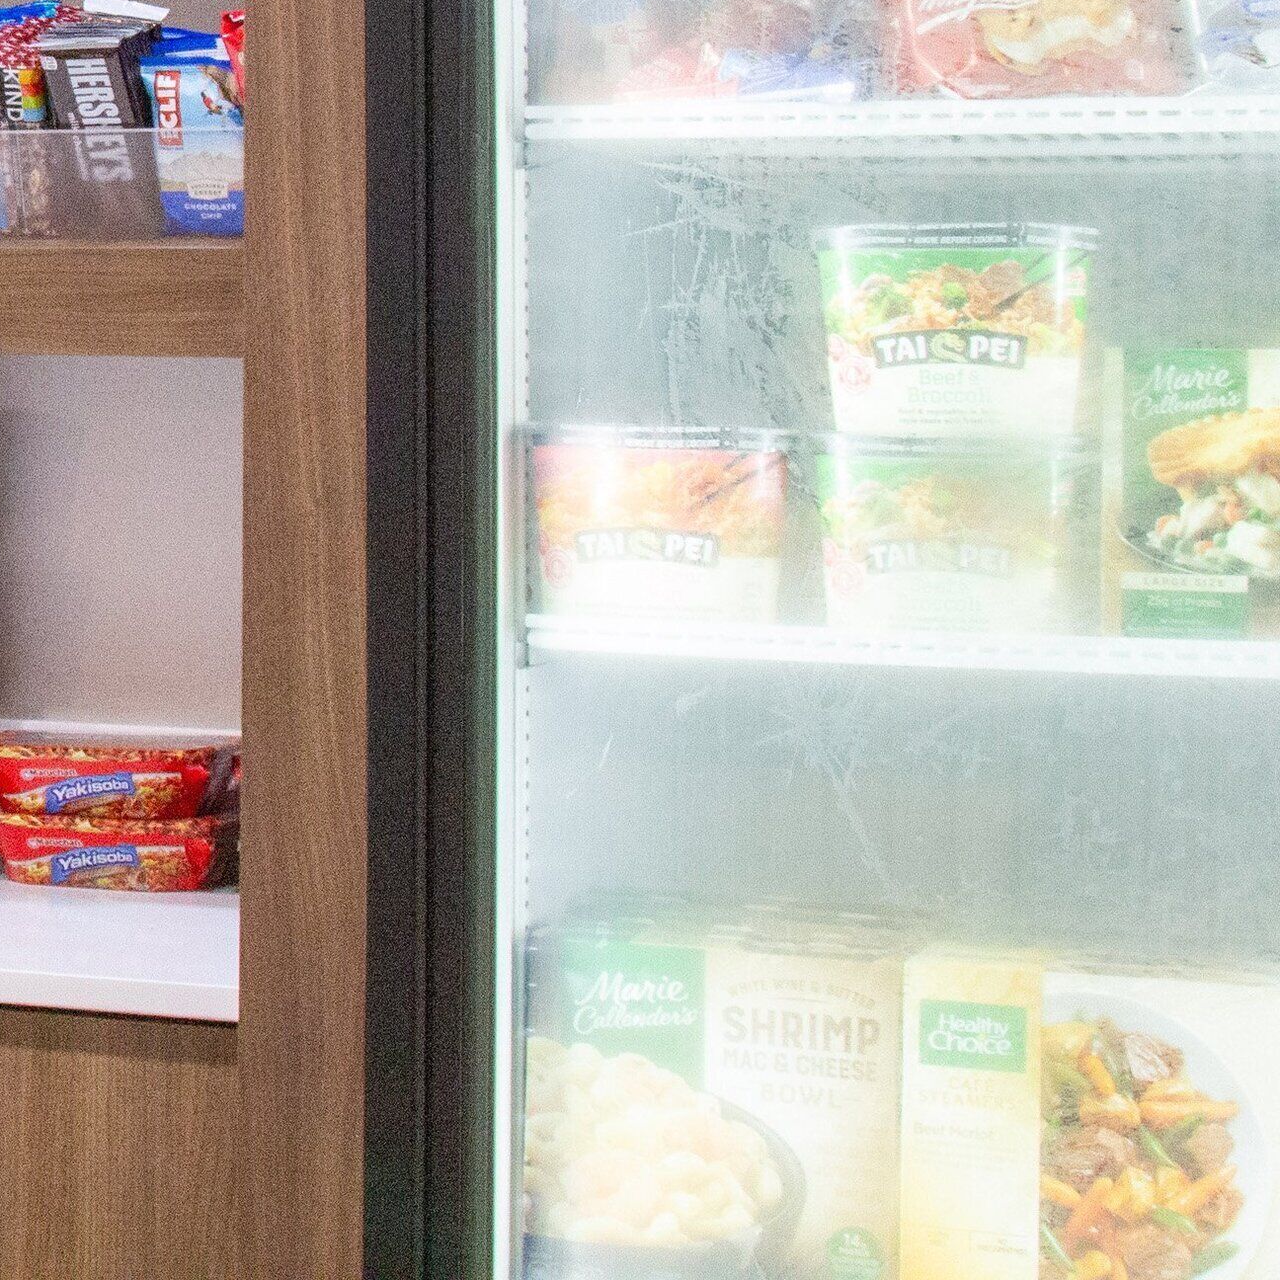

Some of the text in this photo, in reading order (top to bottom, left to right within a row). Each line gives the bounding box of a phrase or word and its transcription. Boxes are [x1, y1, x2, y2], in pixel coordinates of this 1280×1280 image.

[4, 69, 25, 121] KIND
[160, 73, 180, 131] CLIF
[876, 334, 1023, 363] TAI PEI
[919, 368, 965, 385] Beef
[1136, 363, 1234, 396] Marie
[908, 387, 993, 406] Broccoli
[579, 534, 714, 562] TAI PEI
[870, 544, 1011, 572] TAI PEI
[53, 780, 130, 802] Yakisoba
[59, 850, 134, 871] Yakisoba
[575, 970, 688, 1007] Marie
[774, 978, 806, 993] WINE
[826, 983, 876, 1009] BUTTER
[574, 1003, 700, 1036] Callender's
[723, 1005, 881, 1055] SHRIMP
[940, 1014, 1009, 1039] Healthy
[927, 1030, 1012, 1056] Choice
[724, 1049, 878, 1083] MAC & CHEESE
[761, 1084, 843, 1109] BOWL
